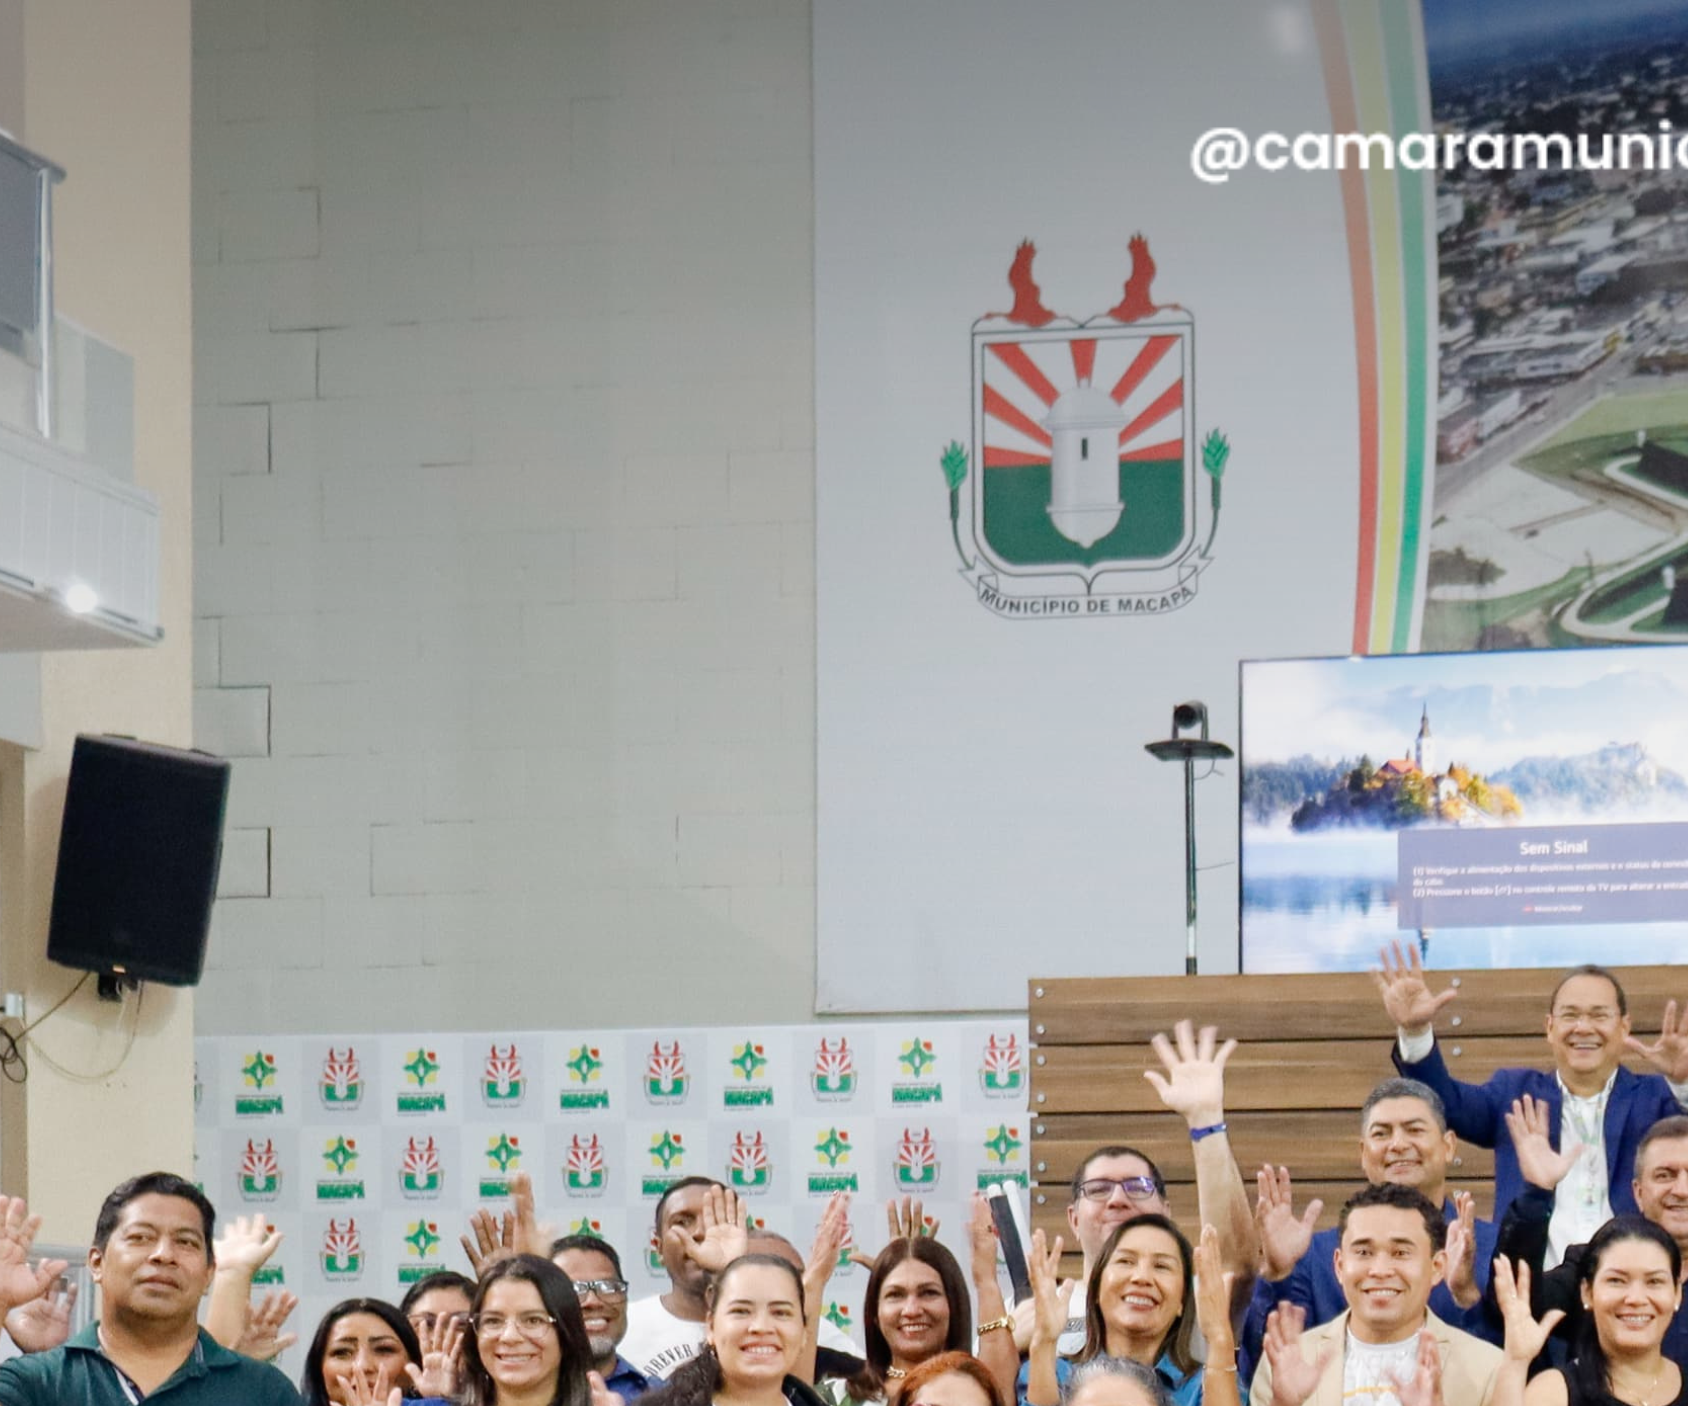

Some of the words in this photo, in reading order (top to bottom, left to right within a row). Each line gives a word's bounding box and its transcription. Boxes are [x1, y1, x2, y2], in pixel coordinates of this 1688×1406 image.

[1087, 600, 1110, 613] DE
[1520, 842, 1550, 855] Sem
[1554, 840, 1588, 854] Sinal
